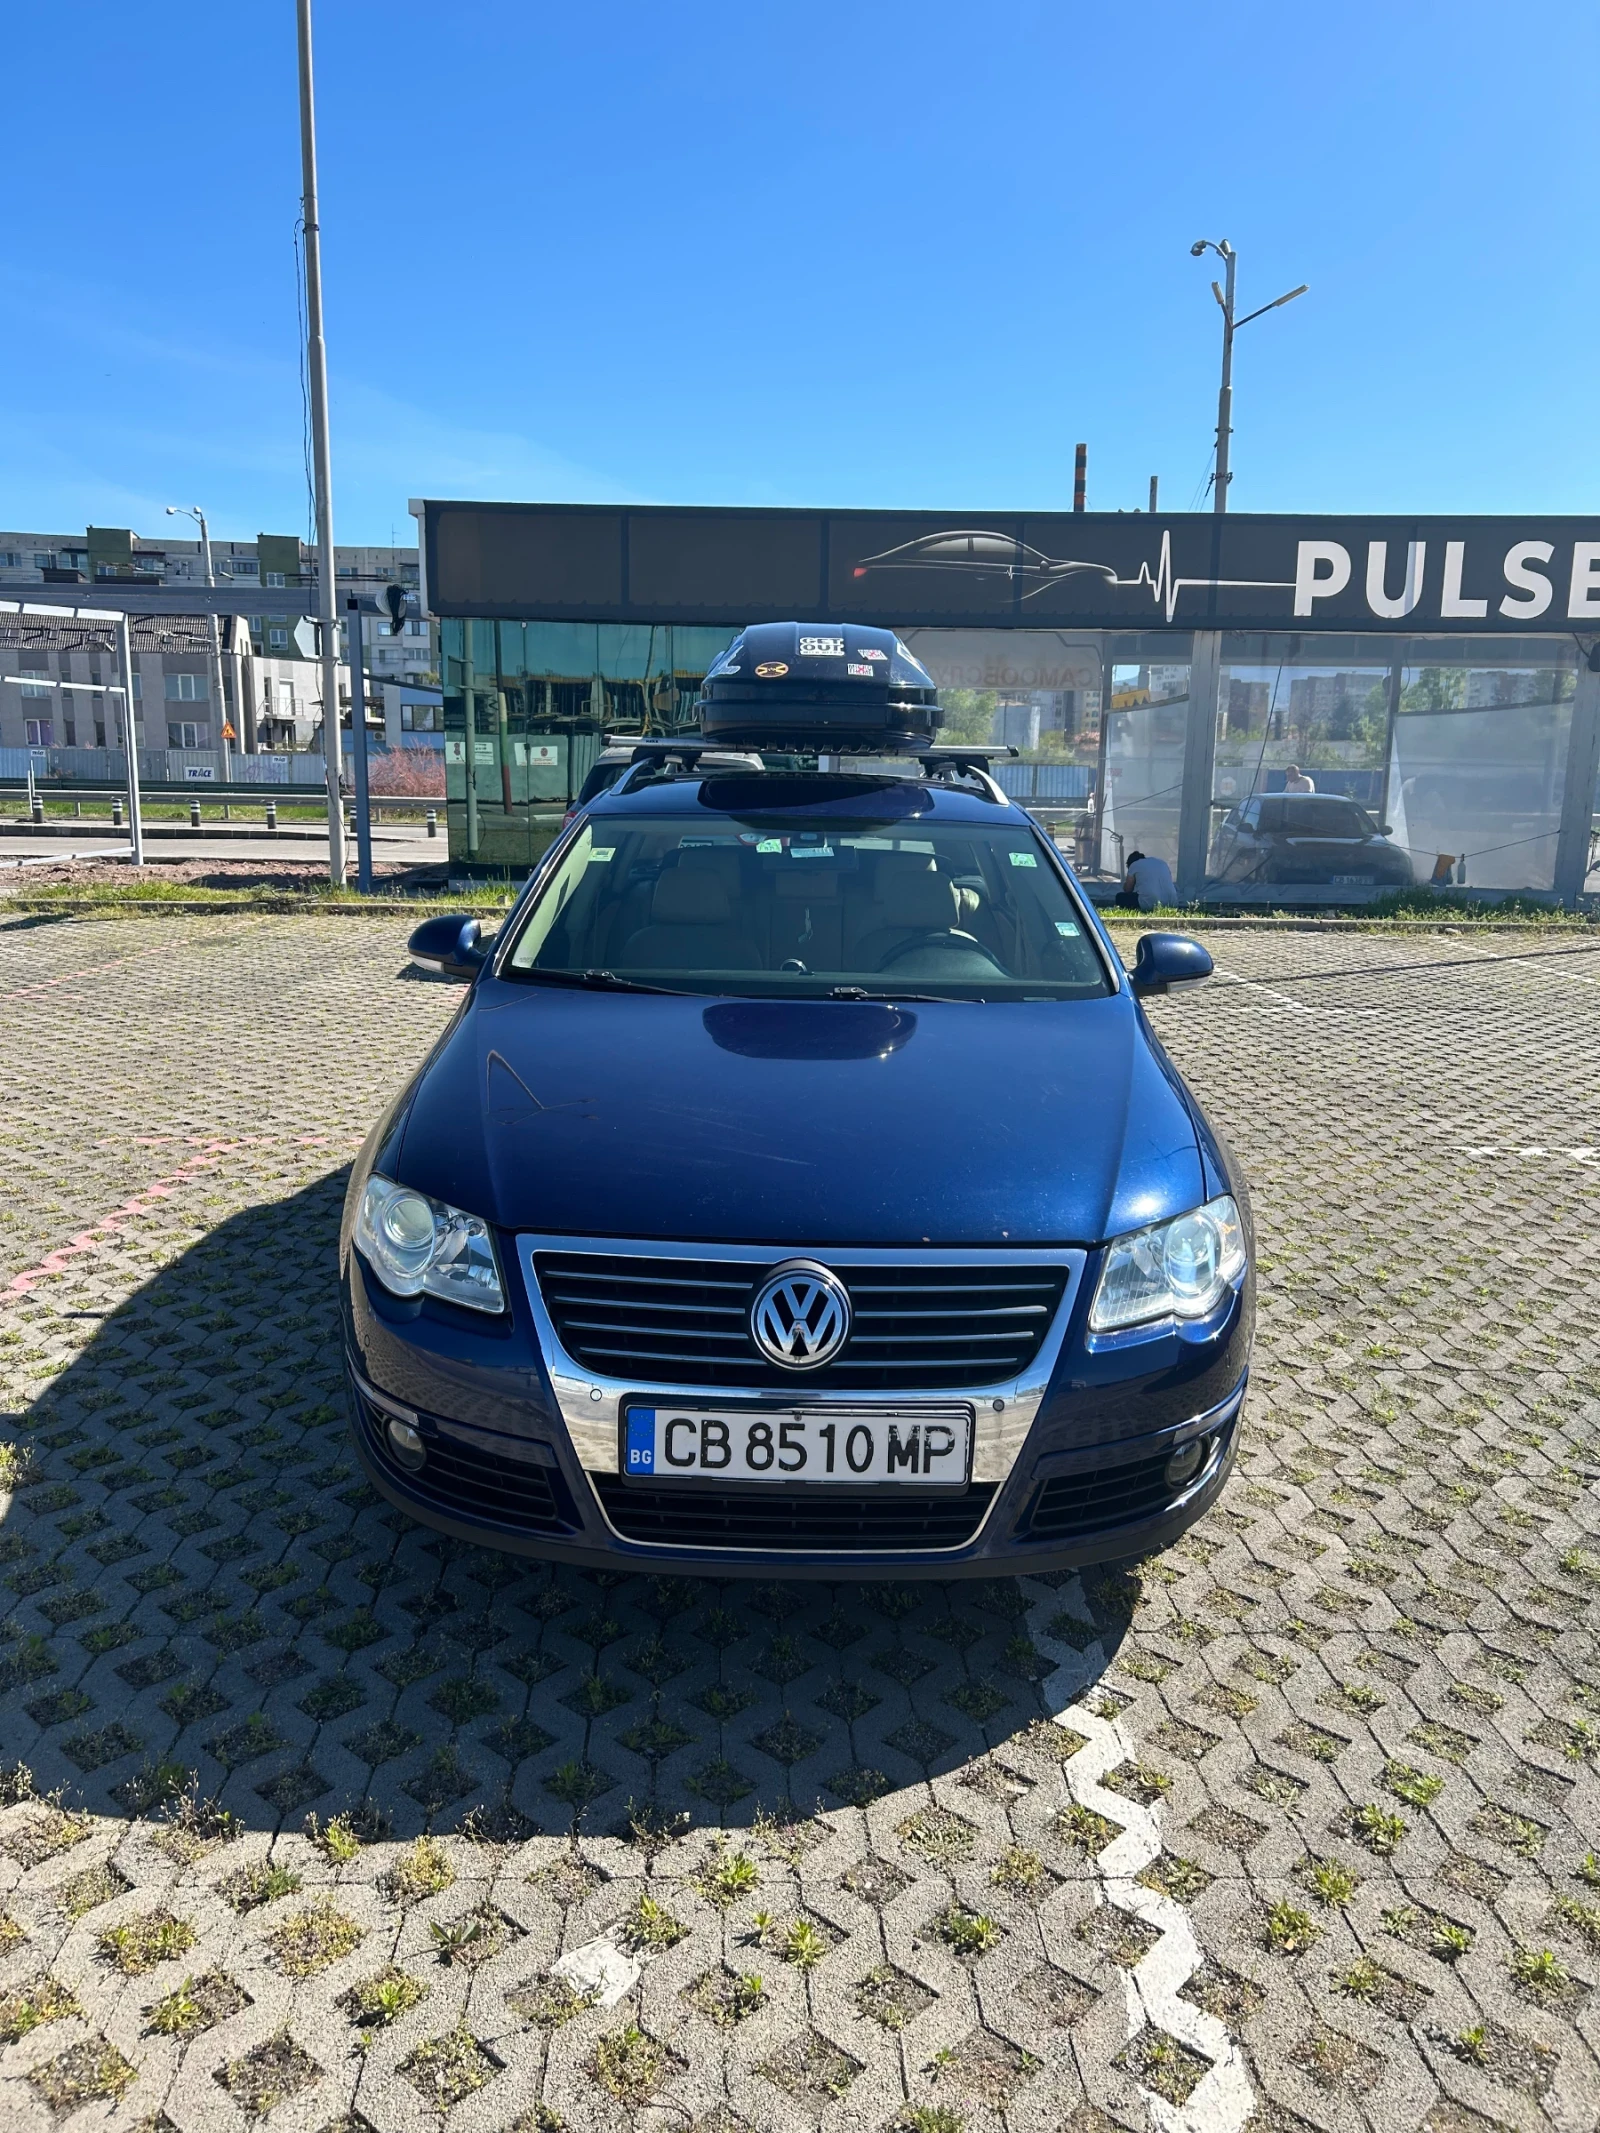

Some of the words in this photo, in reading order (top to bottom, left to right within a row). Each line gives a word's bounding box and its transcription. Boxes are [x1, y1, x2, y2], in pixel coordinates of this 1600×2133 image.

[1294, 540, 1600, 619] PULSE
[188, 768, 212, 778] TRACE
[630, 1449, 652, 1464] BG
[665, 1418, 732, 1469] CB
[747, 1422, 874, 1473] 8510
[887, 1425, 956, 1474] MP
